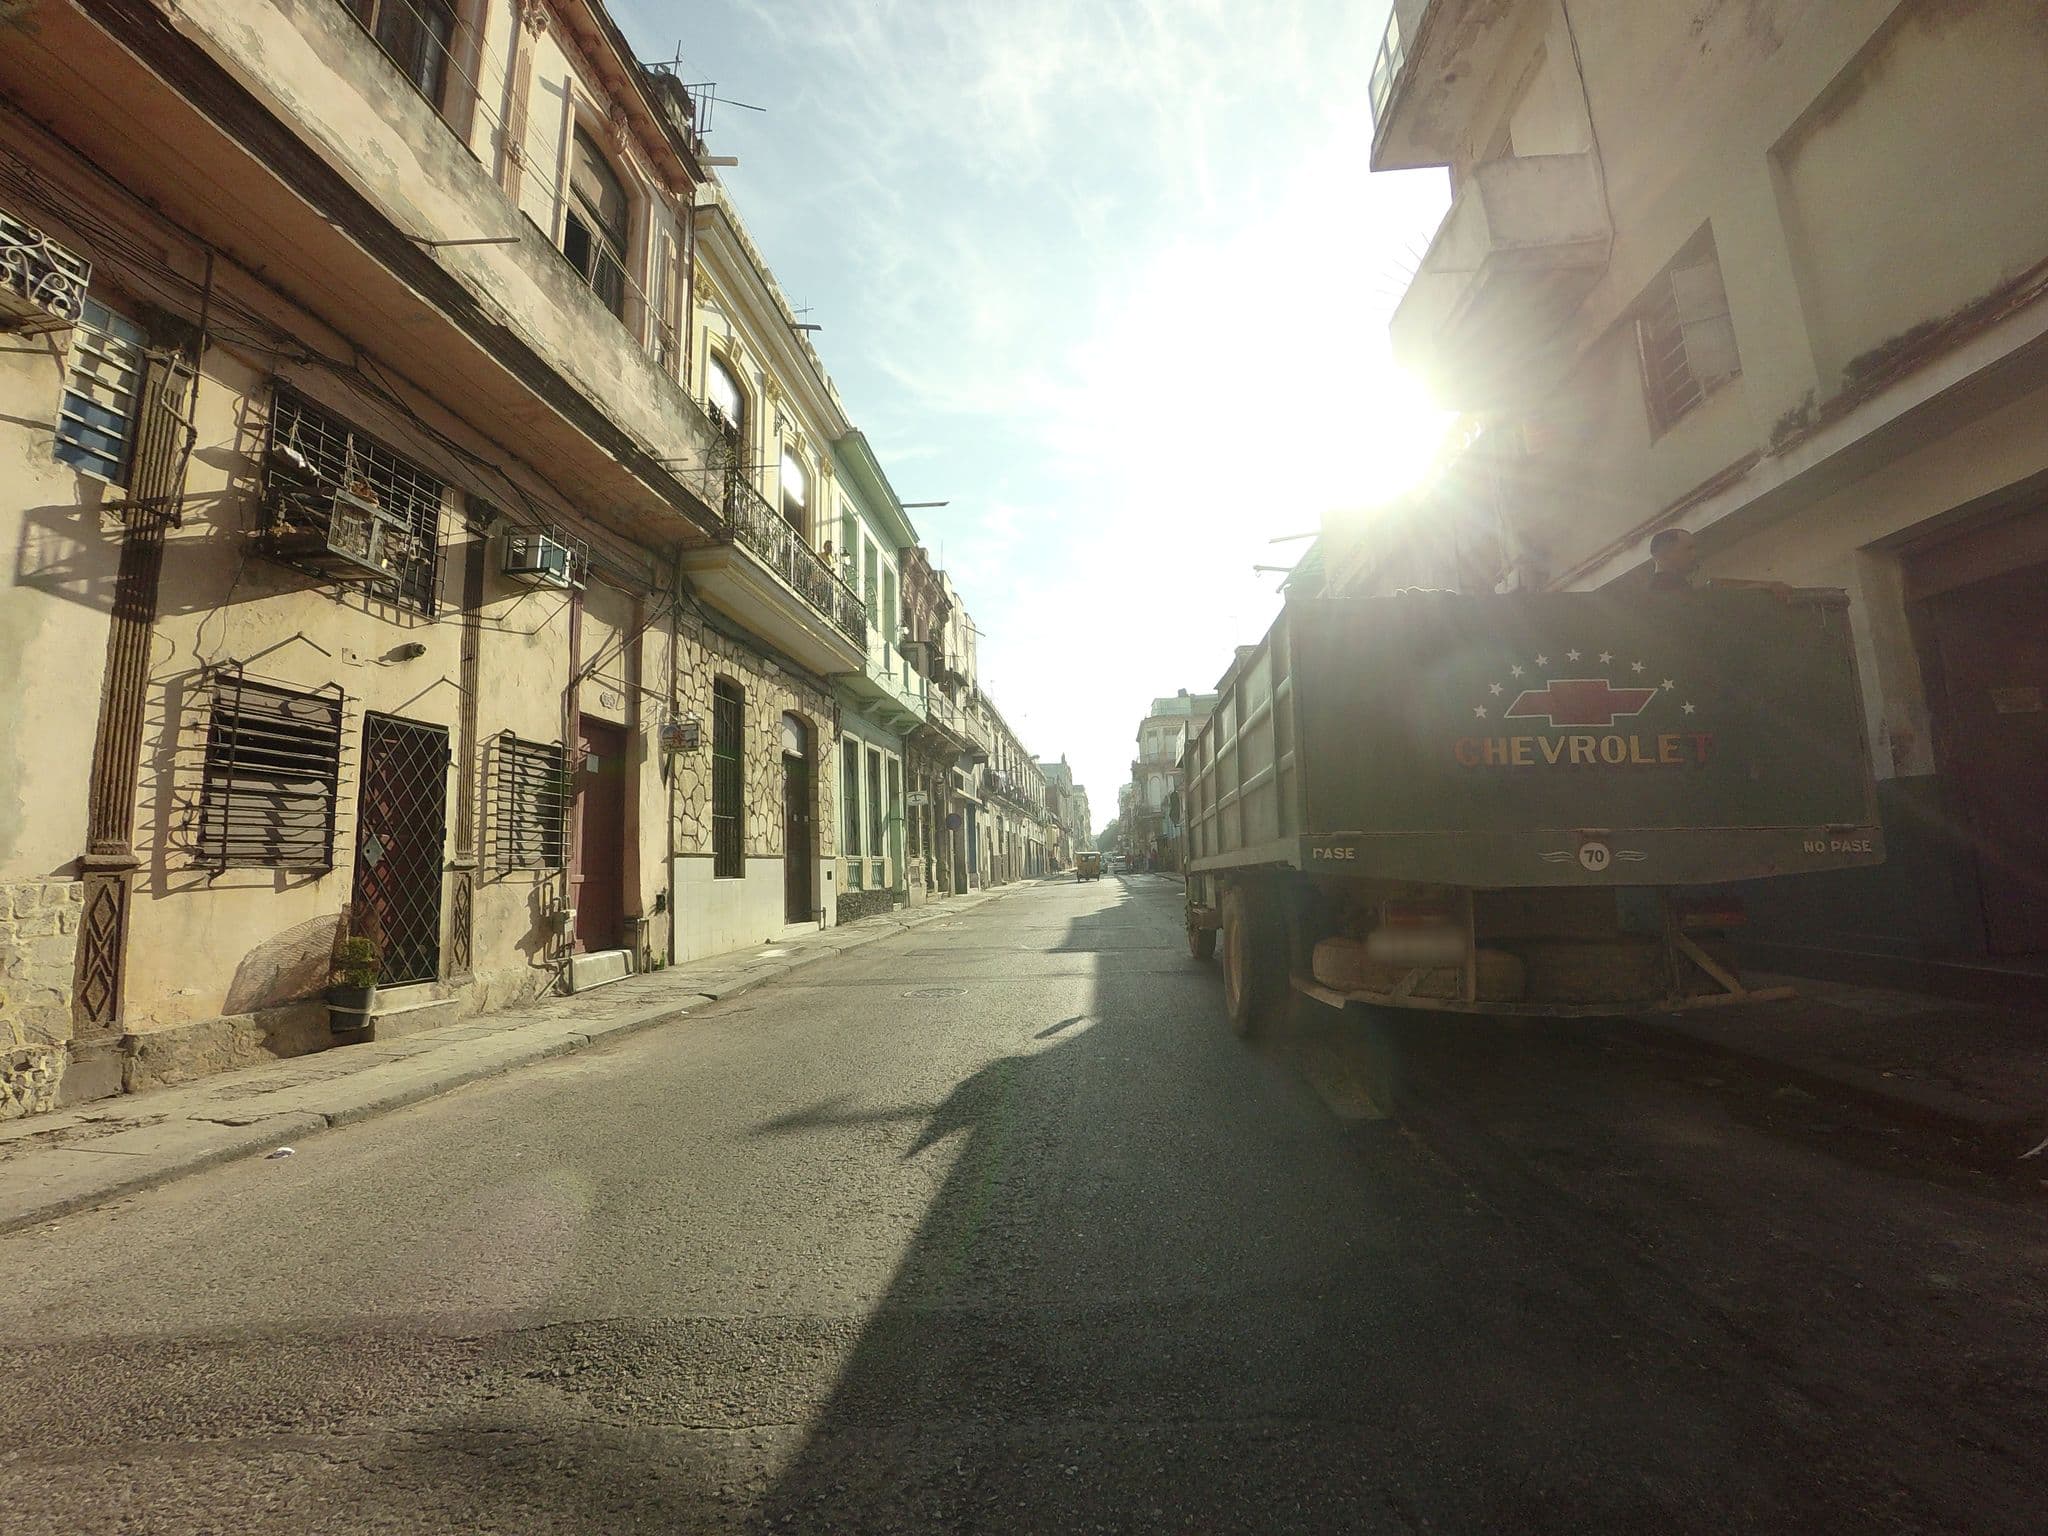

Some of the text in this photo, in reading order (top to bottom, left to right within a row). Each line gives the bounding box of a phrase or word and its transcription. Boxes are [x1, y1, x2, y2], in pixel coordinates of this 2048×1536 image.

[1454, 733, 1713, 765] CHEVROLET
[1803, 840, 1872, 852] NO PASE
[1584, 849, 1604, 863] 70
